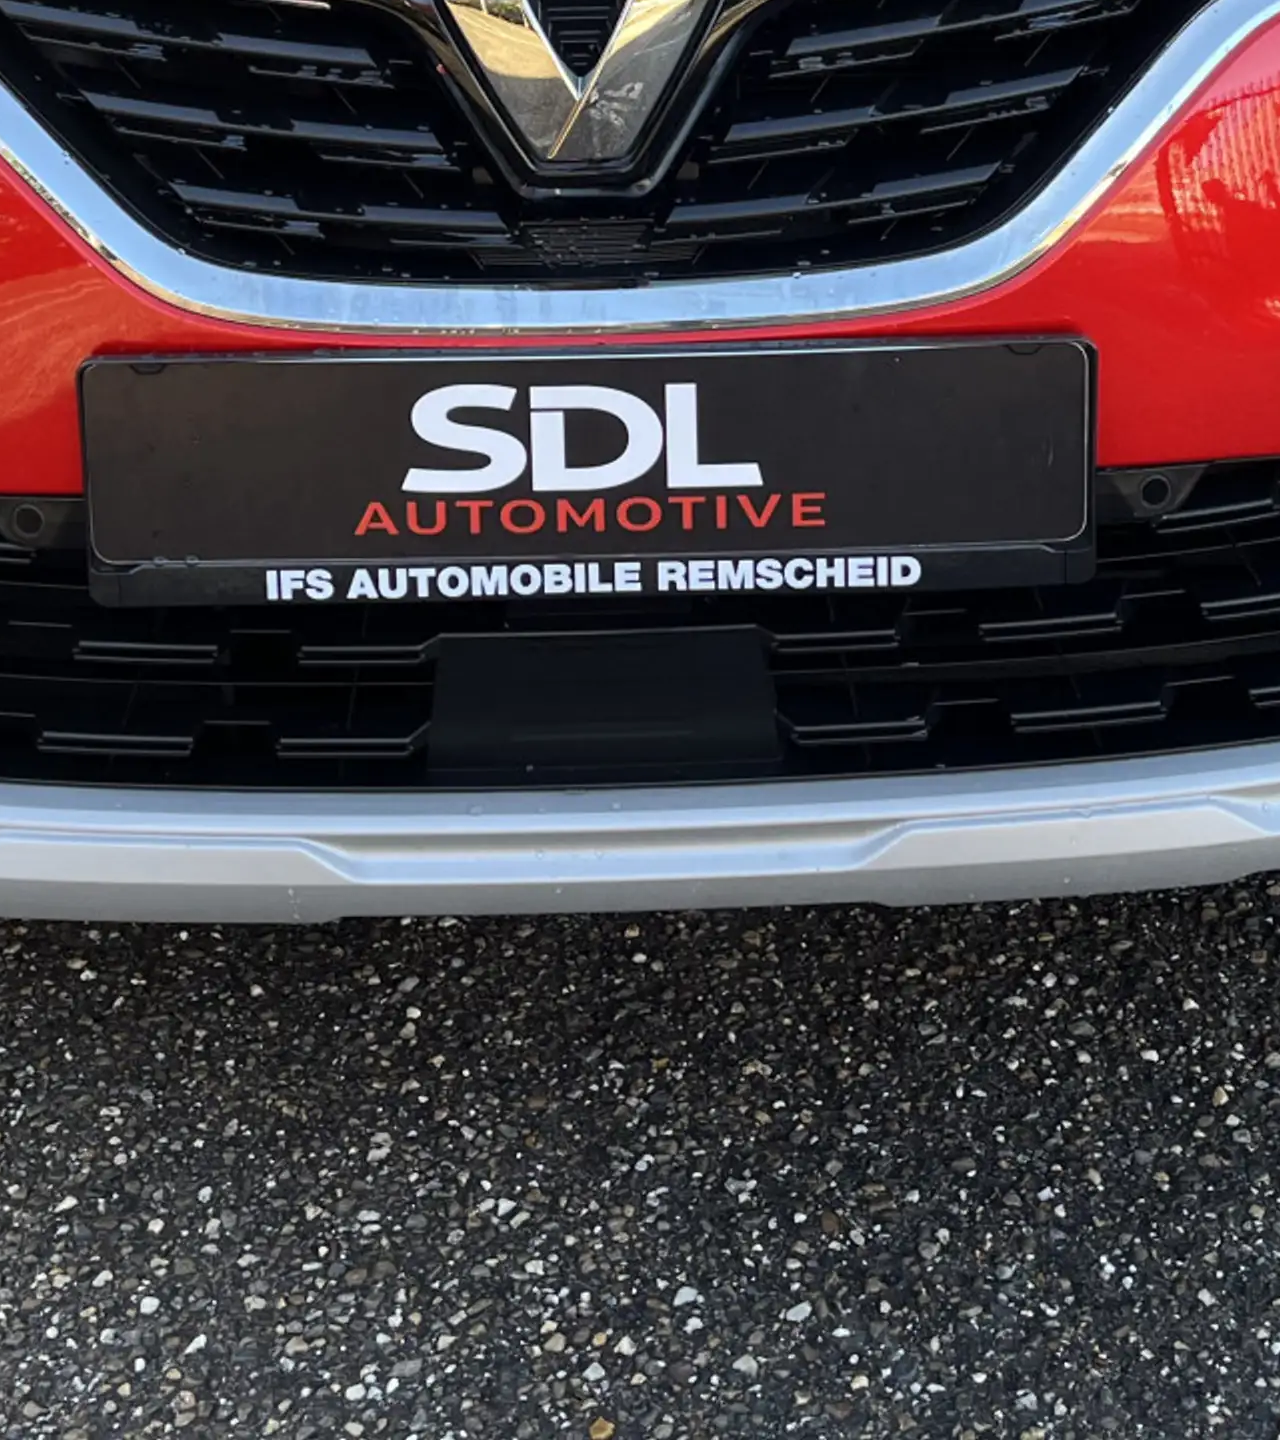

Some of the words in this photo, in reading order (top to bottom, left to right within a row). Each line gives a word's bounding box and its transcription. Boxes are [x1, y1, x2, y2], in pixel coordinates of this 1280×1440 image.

[402, 383, 764, 493] SDL
[354, 492, 827, 536] AUTOMOTIVE
[266, 569, 335, 601] IFS
[346, 561, 642, 600] AUTOMOBILE
[657, 556, 922, 592] REMSCHEID
